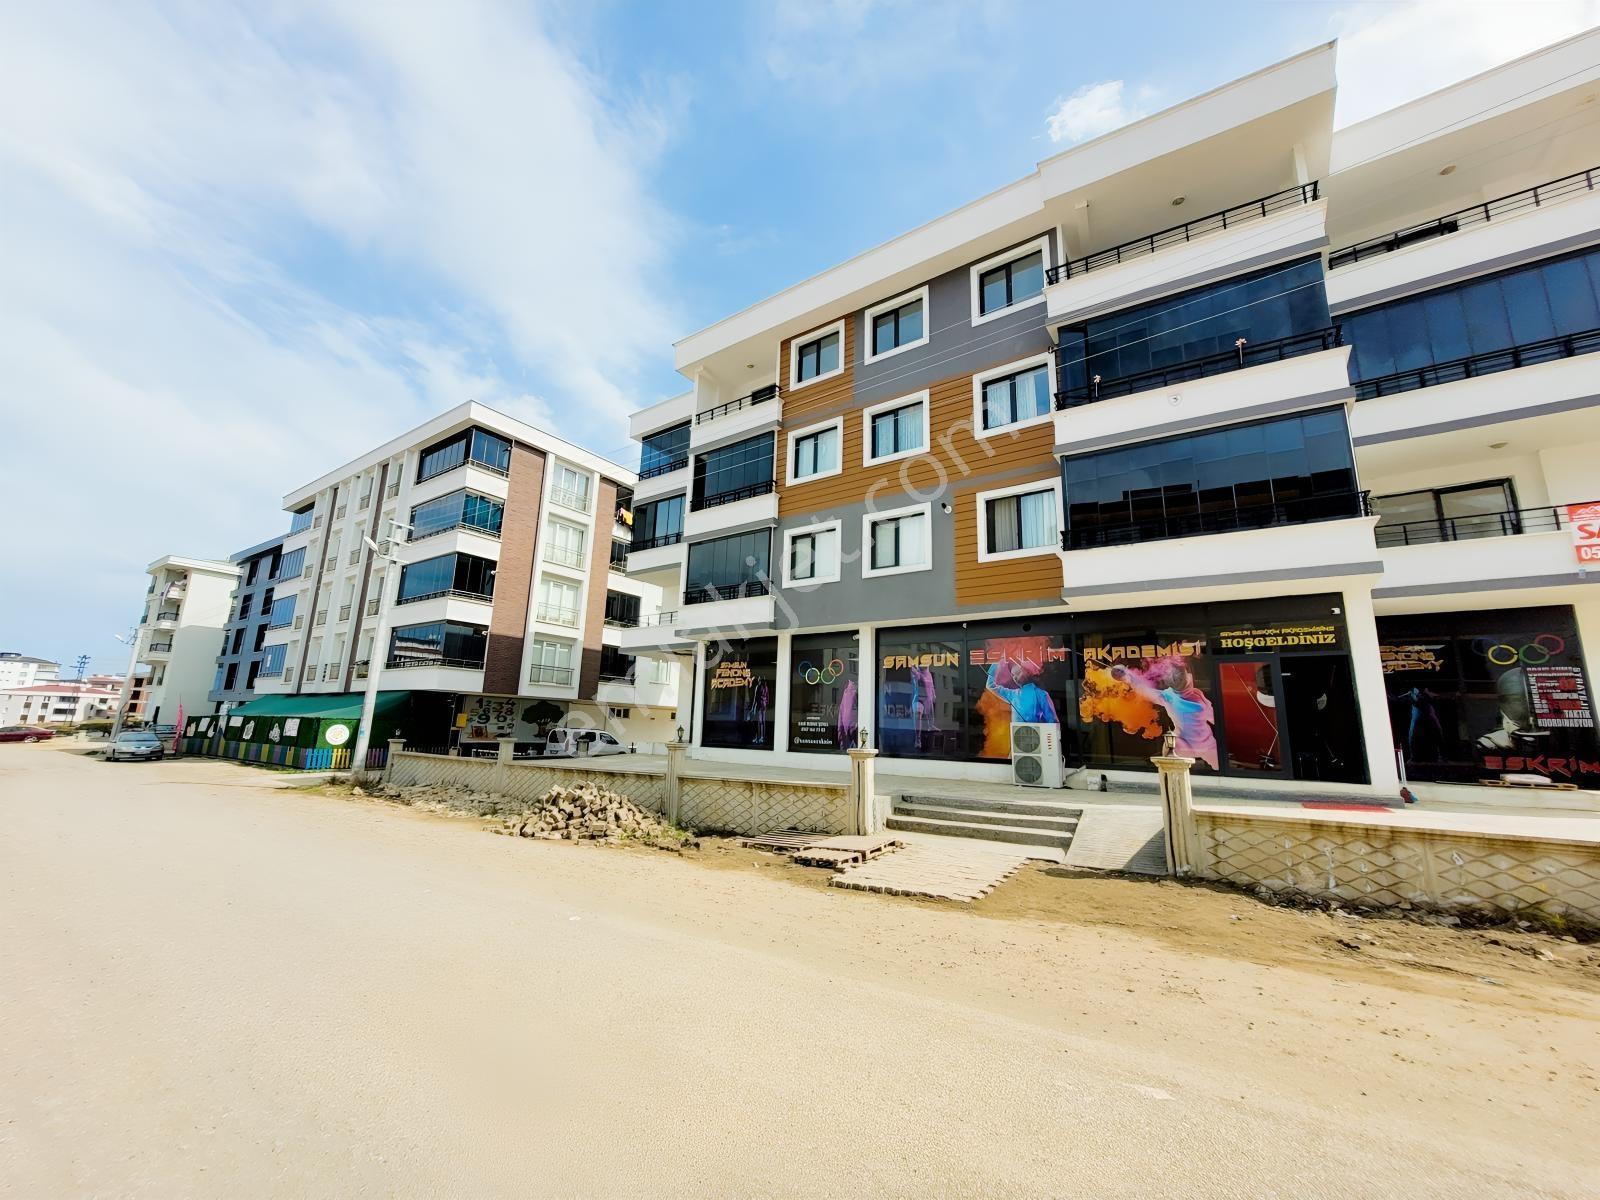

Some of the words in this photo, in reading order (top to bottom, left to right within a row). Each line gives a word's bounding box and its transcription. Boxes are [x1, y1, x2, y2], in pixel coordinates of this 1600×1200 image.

[1221, 632, 1336, 649] HOŞGELDİNİZ
[883, 652, 959, 671] SAMSUN
[710, 676, 756, 690] ACADEMY
